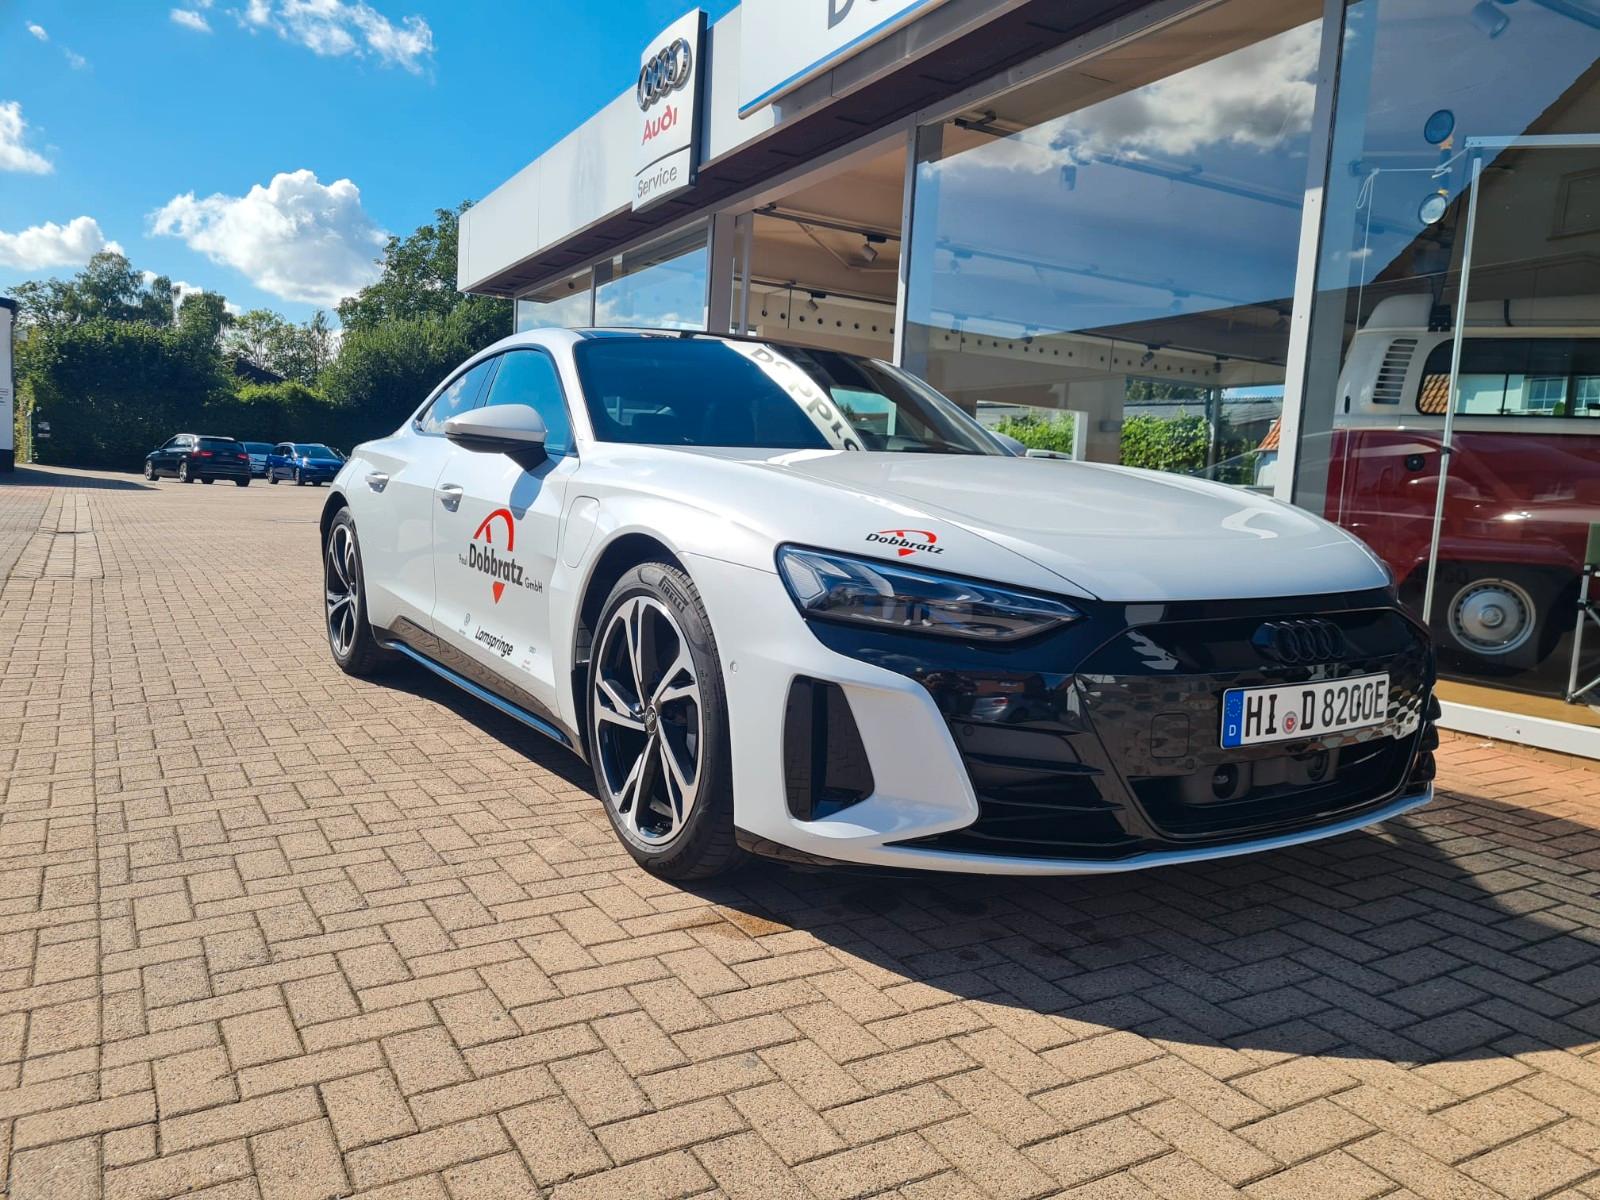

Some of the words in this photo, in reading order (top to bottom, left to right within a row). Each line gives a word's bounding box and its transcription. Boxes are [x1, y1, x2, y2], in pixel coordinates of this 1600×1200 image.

[642, 105, 678, 145] Audi
[638, 166, 678, 199] Service
[865, 533, 945, 554] Dobbratz
[469, 543, 524, 586] Dobbratz
[525, 577, 543, 593] GmbH
[658, 576, 689, 613] PIRELLI
[475, 625, 514, 657] Lamspringe
[1245, 694, 1278, 737] HI
[1301, 690, 1316, 730] D
[1322, 680, 1386, 727] 8200E
[1228, 724, 1237, 737] D
